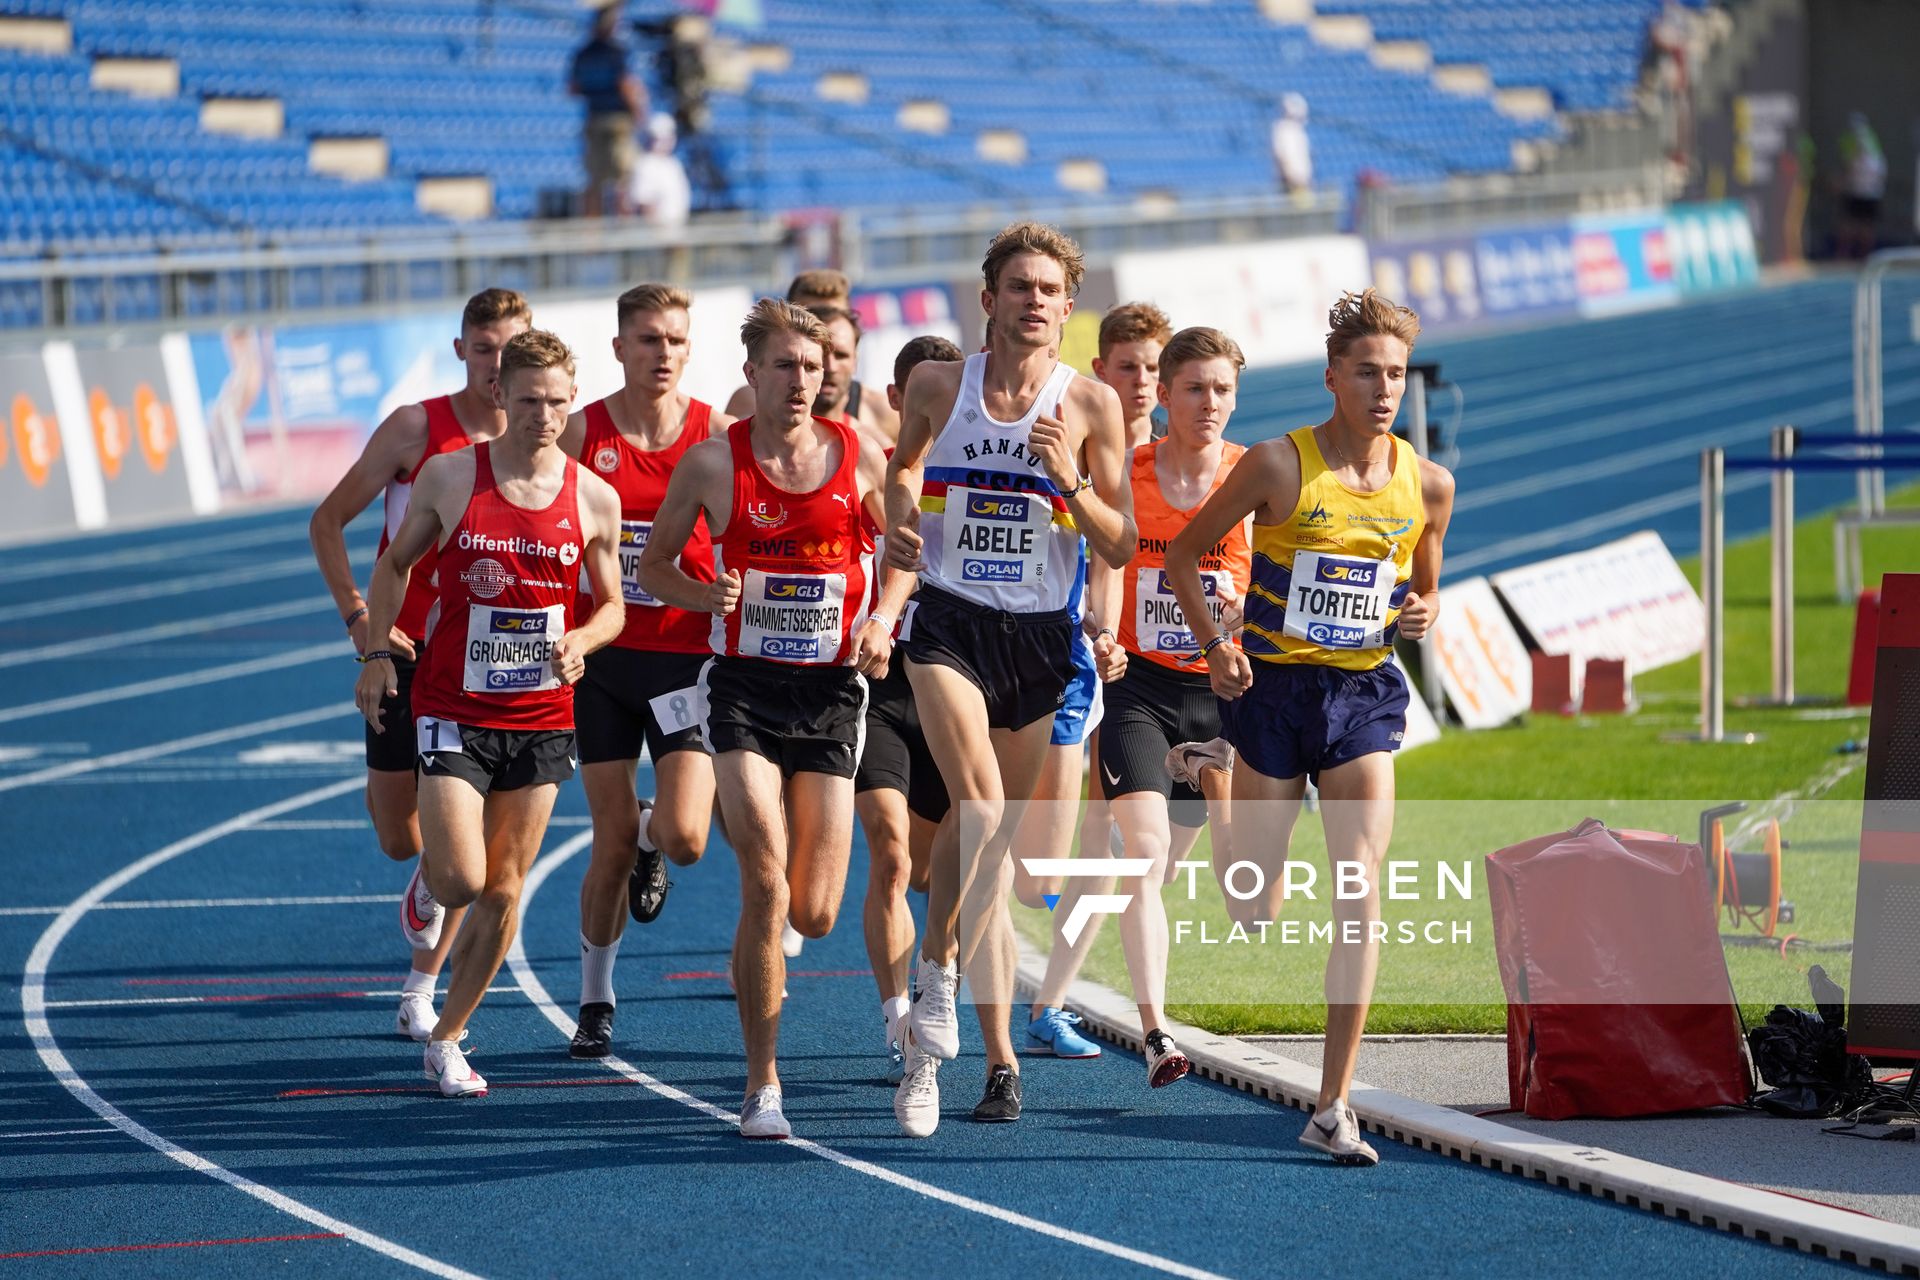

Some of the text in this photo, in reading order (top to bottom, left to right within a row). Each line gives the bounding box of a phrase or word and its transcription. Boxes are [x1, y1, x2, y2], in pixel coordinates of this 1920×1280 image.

[963, 438, 1041, 467] HANAU
[748, 502, 766, 514] LG
[998, 503, 1023, 517] GLS
[458, 530, 557, 558] Öffentliche
[957, 524, 1034, 554] ABELE
[749, 540, 797, 556] SWE
[987, 564, 1020, 575] PLAN
[1348, 568, 1372, 583] GLS
[460, 573, 515, 584] MIETENS
[796, 585, 820, 598] GLS
[1298, 586, 1379, 620] TORTELL
[521, 619, 544, 630] GLS
[744, 603, 839, 633] WAMMETSBERGER
[1332, 629, 1363, 641] PLAN
[785, 642, 817, 652] PLAN
[509, 671, 540, 681] PLAN
[669, 695, 690, 728] 8
[425, 722, 440, 749] 1
